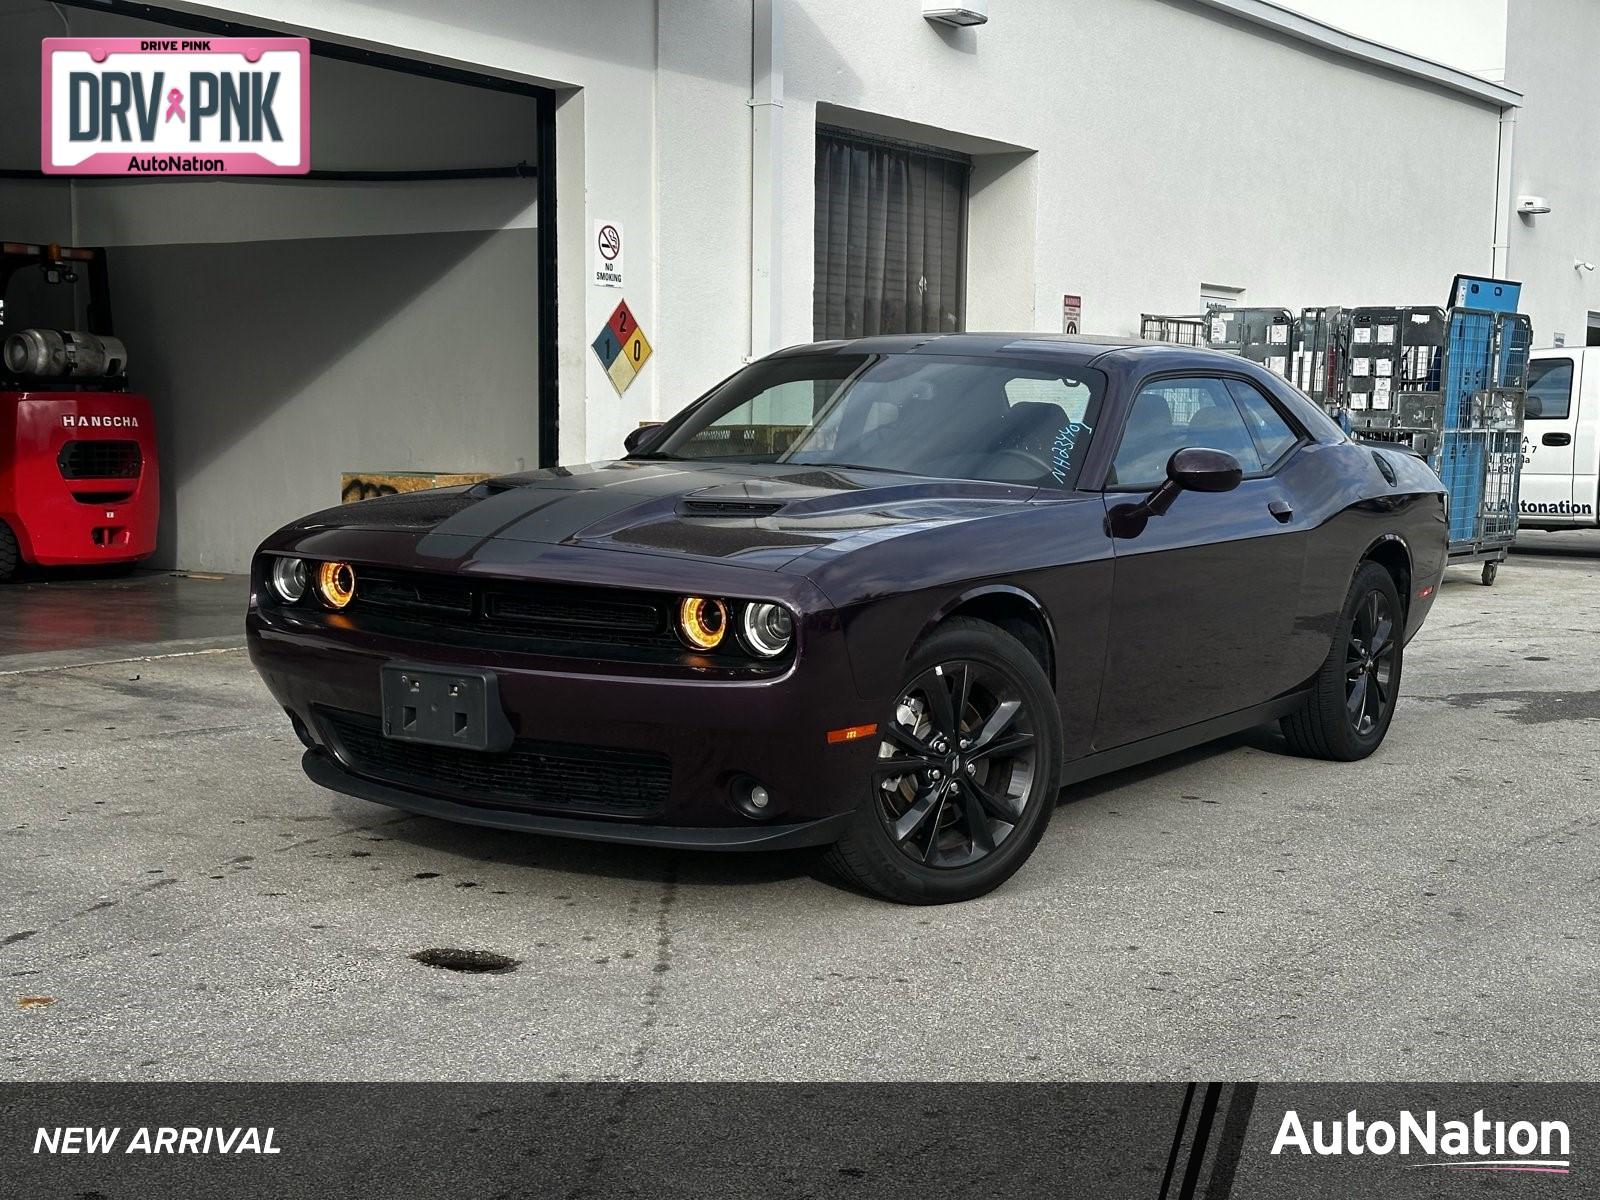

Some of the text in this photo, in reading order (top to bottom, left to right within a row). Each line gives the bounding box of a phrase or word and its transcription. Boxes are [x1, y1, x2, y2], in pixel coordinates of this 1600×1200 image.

[605, 262, 614, 271] NO
[596, 271, 622, 283] SMOKING
[620, 311, 627, 333] 2
[604, 339, 610, 360] 1
[634, 340, 640, 361] 0
[63, 416, 139, 427] HANGCHA
